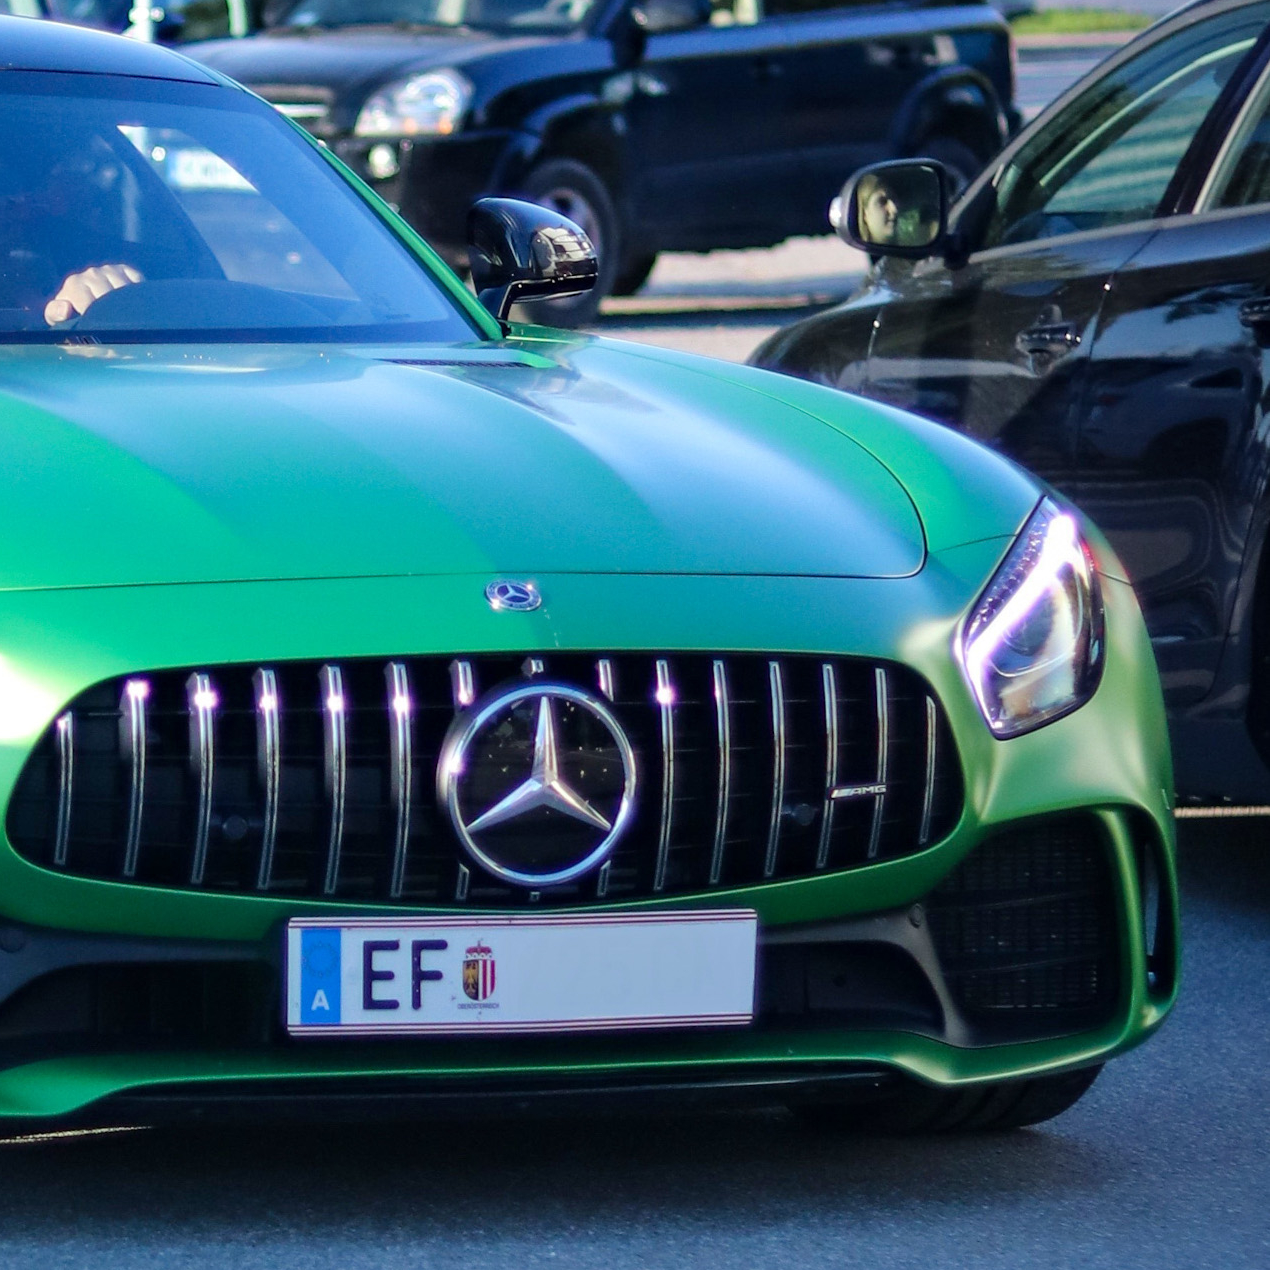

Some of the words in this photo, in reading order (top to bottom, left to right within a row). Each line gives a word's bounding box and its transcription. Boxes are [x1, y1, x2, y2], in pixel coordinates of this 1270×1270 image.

[850, 784, 886, 796] AMG
[363, 939, 448, 1010] EF
[311, 989, 330, 1011] A
